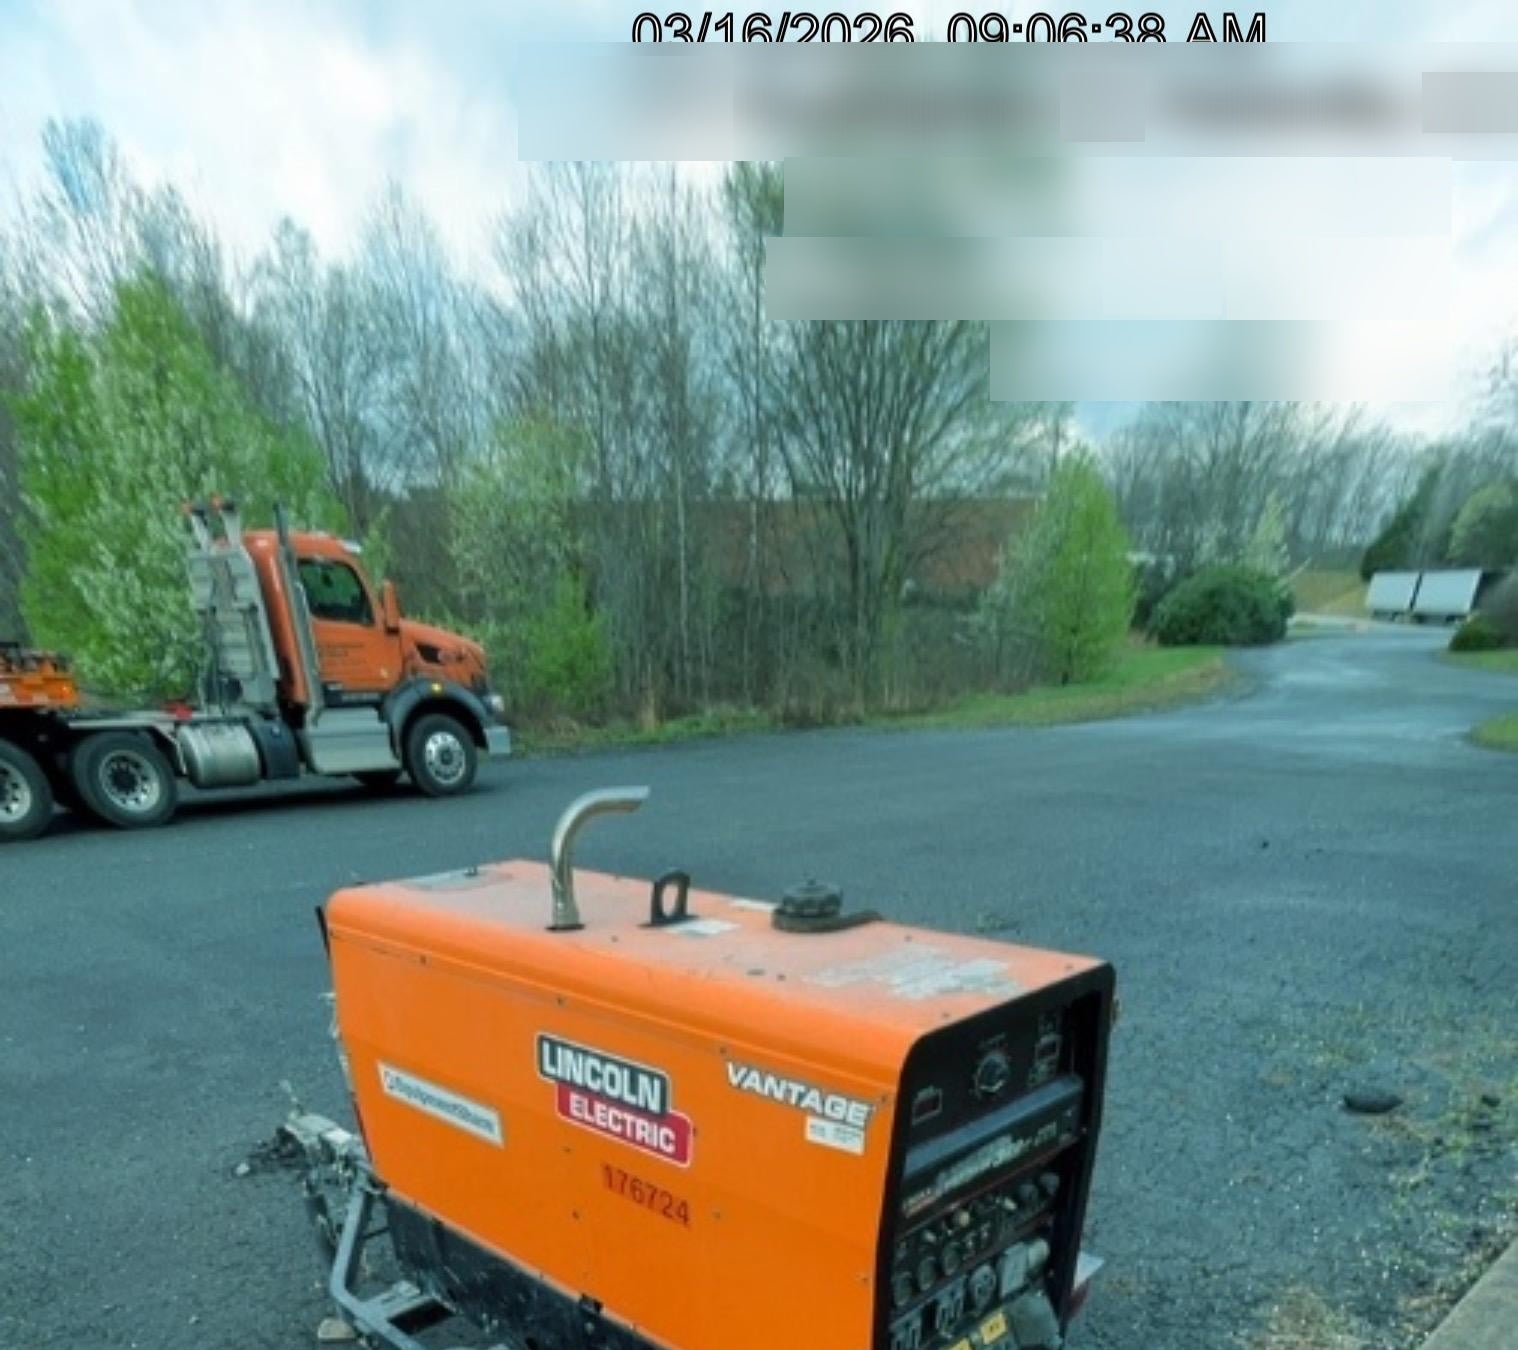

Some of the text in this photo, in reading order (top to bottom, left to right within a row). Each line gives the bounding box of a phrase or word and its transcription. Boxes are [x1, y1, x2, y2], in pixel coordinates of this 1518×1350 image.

[541, 1040, 664, 1115] LINCOLN
[727, 1061, 869, 1124] VANTAGE
[568, 1094, 676, 1154] ELECTRIC
[602, 1163, 692, 1228] 176724
